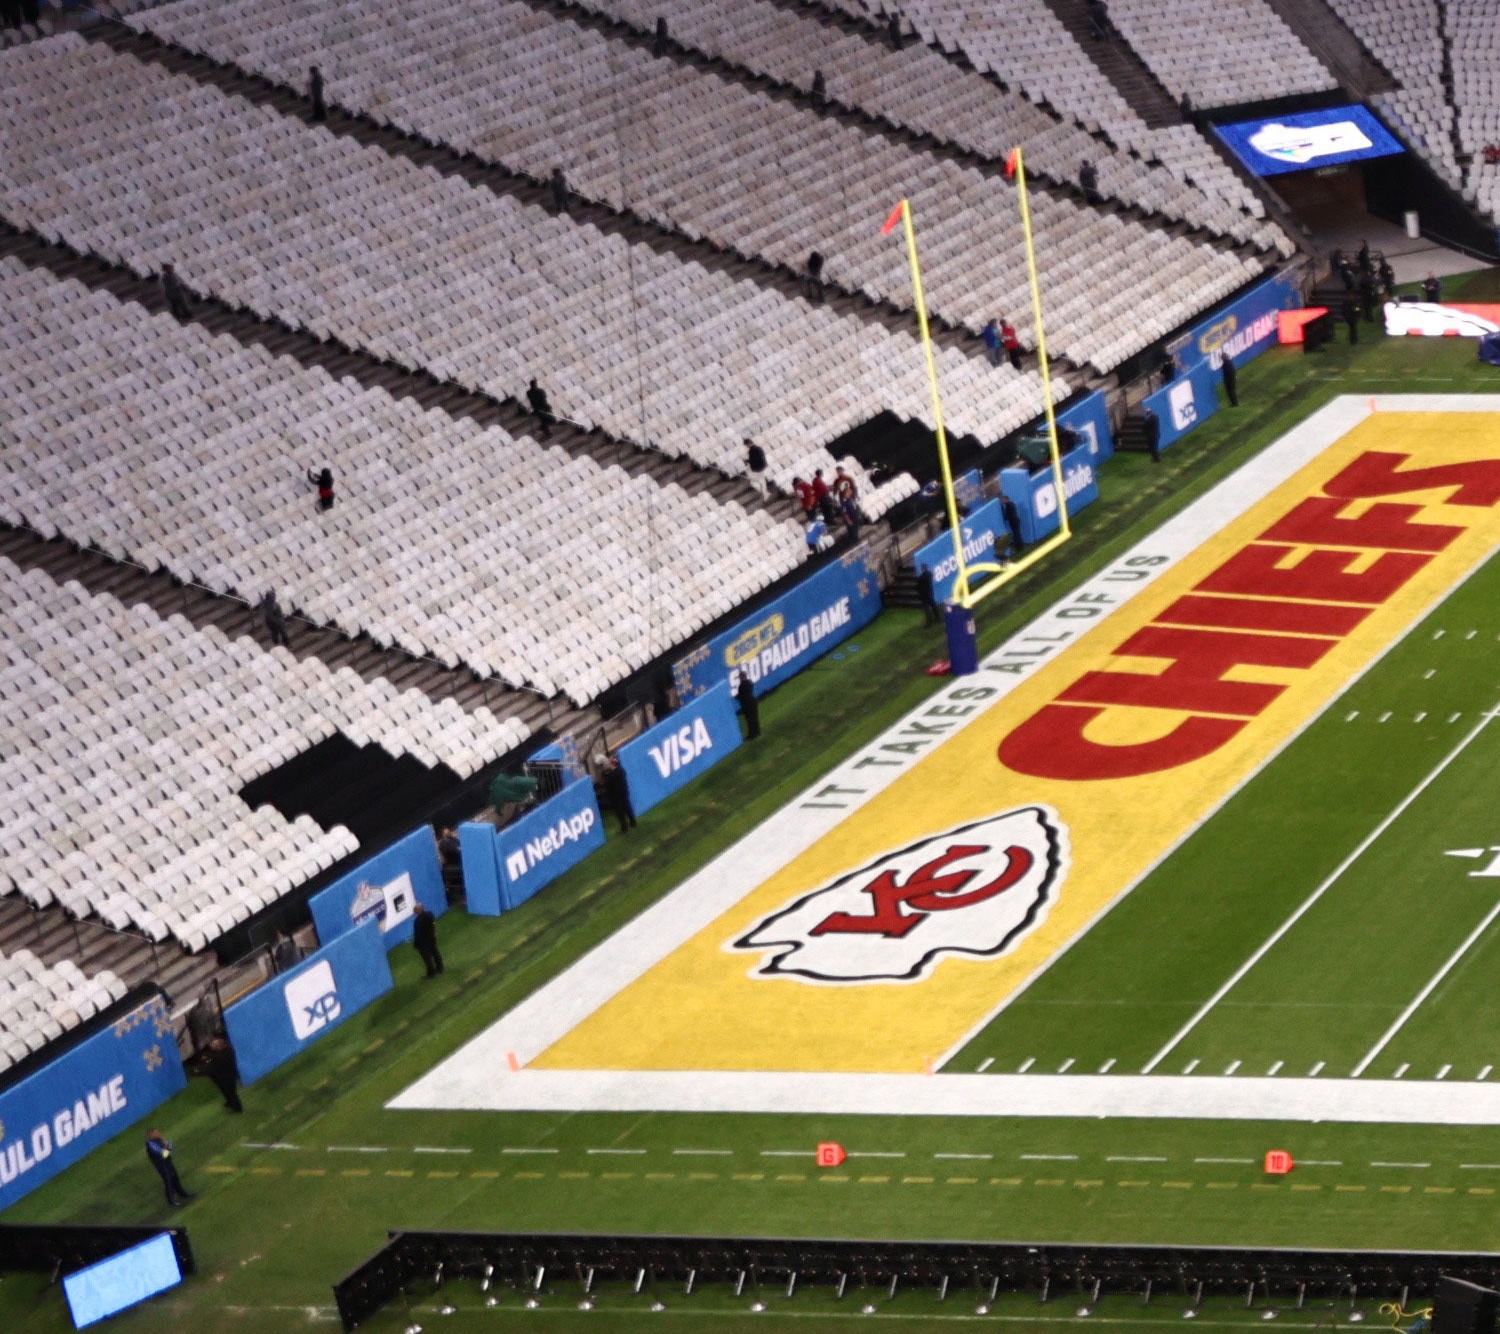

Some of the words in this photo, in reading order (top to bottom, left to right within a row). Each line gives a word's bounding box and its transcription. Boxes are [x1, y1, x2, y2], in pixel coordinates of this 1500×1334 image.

[933, 530, 994, 583] accnture
[761, 624, 810, 677] PAULO
[809, 596, 852, 643] GAME
[800, 784, 866, 808] IT
[854, 686, 999, 770] TAKES
[987, 632, 1070, 675] ALL
[1056, 593, 1120, 620] OF
[1114, 554, 1173, 581] US
[647, 717, 713, 779] VISA
[525, 807, 595, 871] NetApp
[808, 845, 1035, 938] KC
[0, 1124, 52, 1188] ULO
[54, 1074, 128, 1148] GAME
